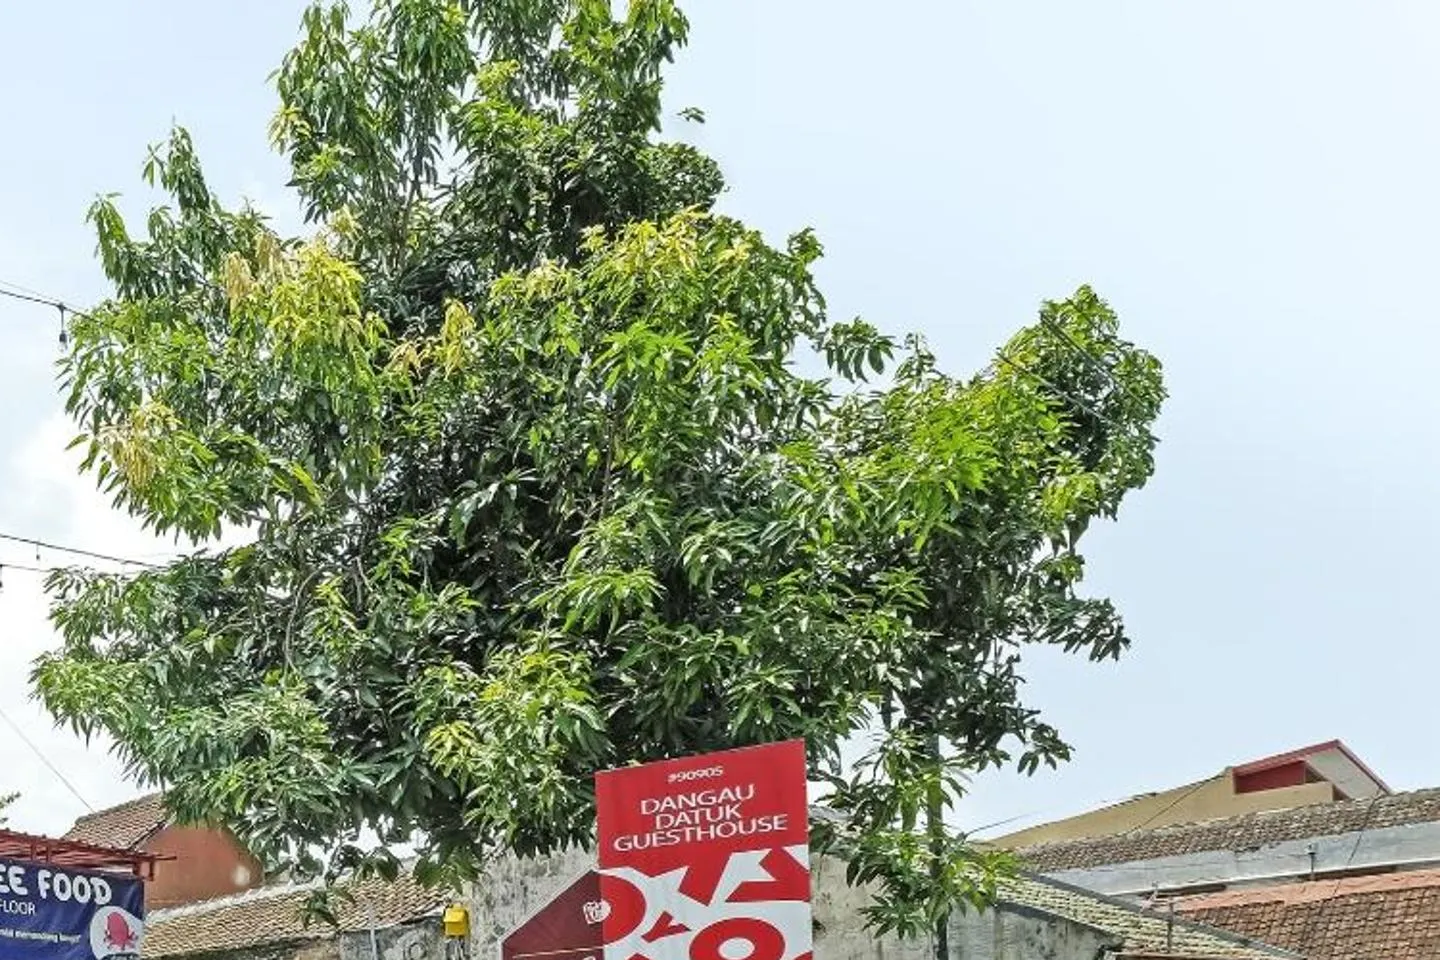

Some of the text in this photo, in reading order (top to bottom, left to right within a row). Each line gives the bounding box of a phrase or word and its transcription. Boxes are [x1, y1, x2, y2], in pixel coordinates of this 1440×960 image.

[641, 783, 755, 815] DANGAU
[613, 813, 788, 851] GUESTHOUSE
[655, 803, 742, 830] DATUK
[38, 870, 112, 905] FOOD
